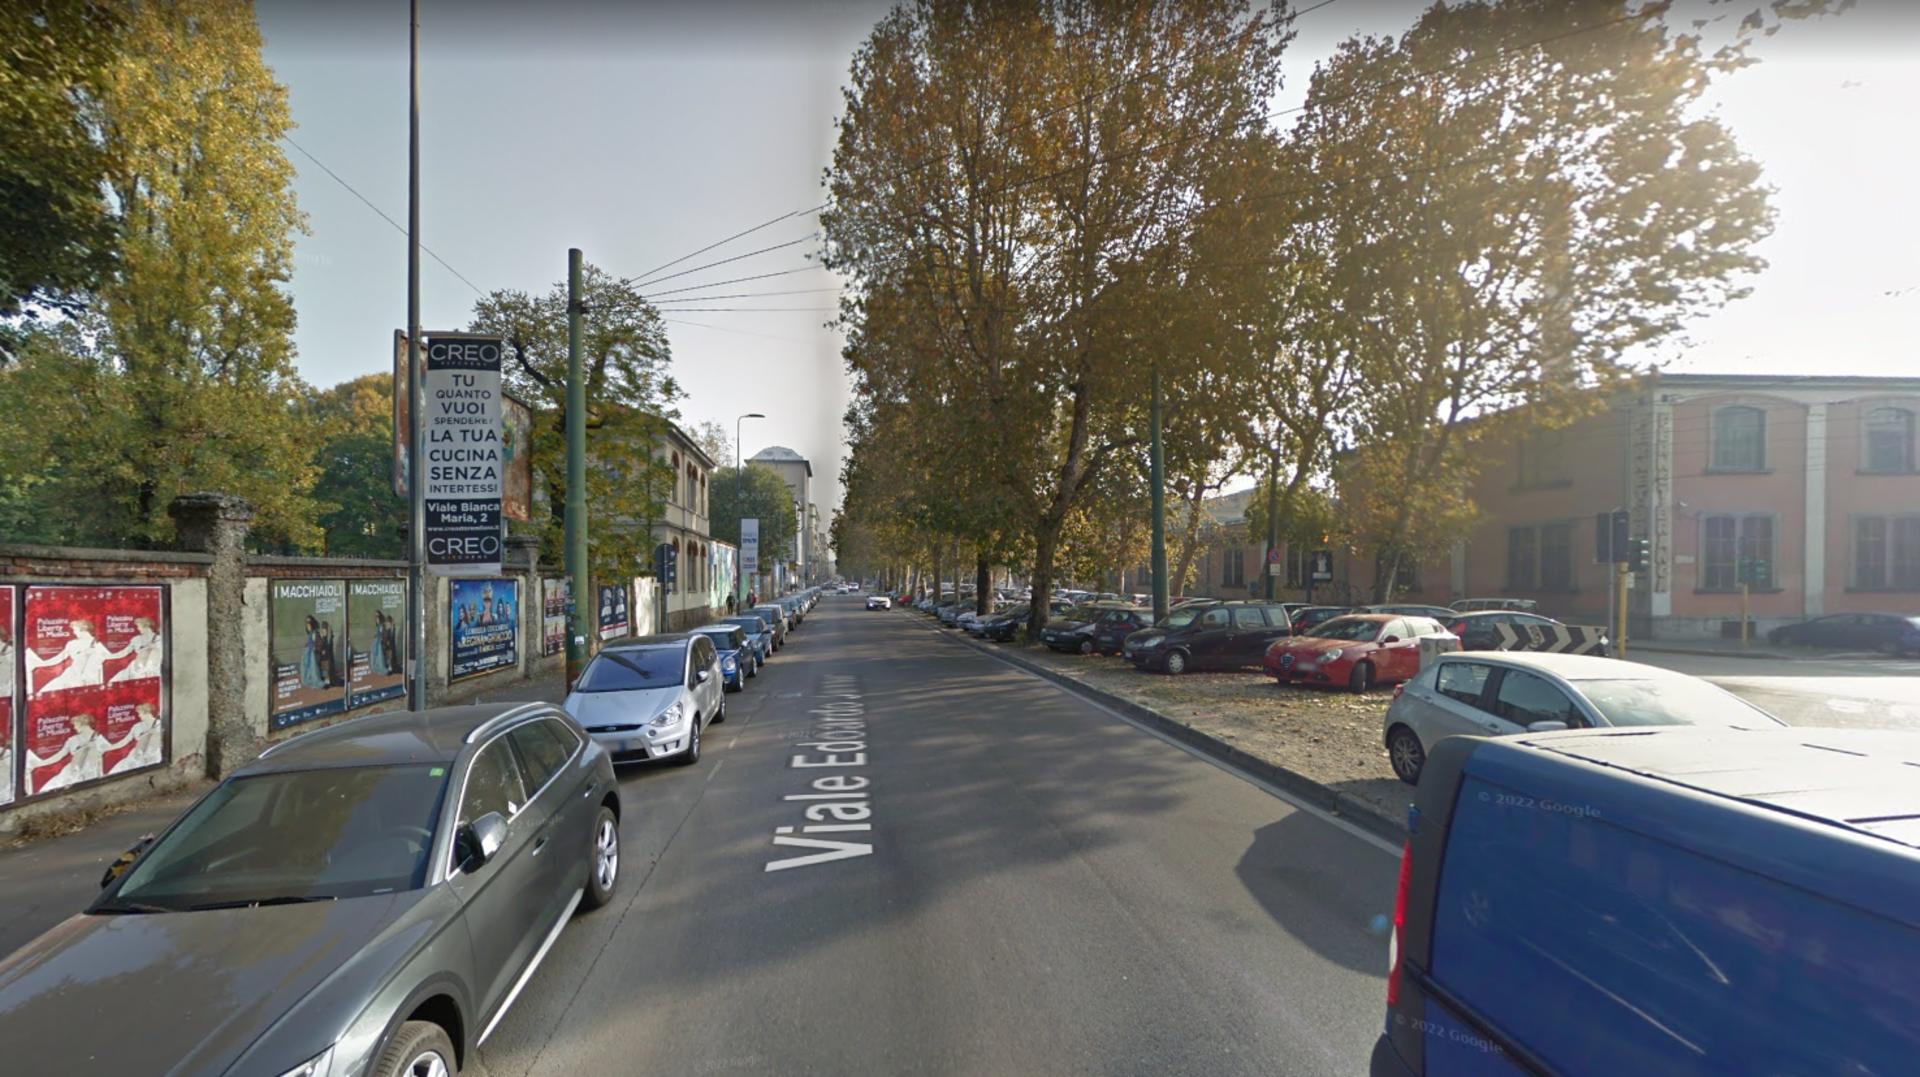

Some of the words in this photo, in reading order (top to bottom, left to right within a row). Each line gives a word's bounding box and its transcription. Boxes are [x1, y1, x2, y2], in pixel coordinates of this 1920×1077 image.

[430, 344, 499, 363] CREO
[452, 374, 475, 387] TU
[436, 389, 492, 400] QUANTO
[441, 401, 485, 415] VUOI
[430, 429, 454, 442] LA
[459, 429, 498, 442] TUA
[430, 449, 498, 462] CUCINA
[430, 466, 497, 480] SENZA
[430, 484, 498, 494] INTERTESSI
[427, 502, 458, 512] Viale
[461, 502, 500, 512] Bianca
[440, 513, 478, 524] Maria,
[480, 512, 488, 522] 2
[428, 536, 499, 555] CREO
[280, 585, 342, 598] MACCHIAIOLI
[356, 584, 405, 595] MACCHIAIOLI
